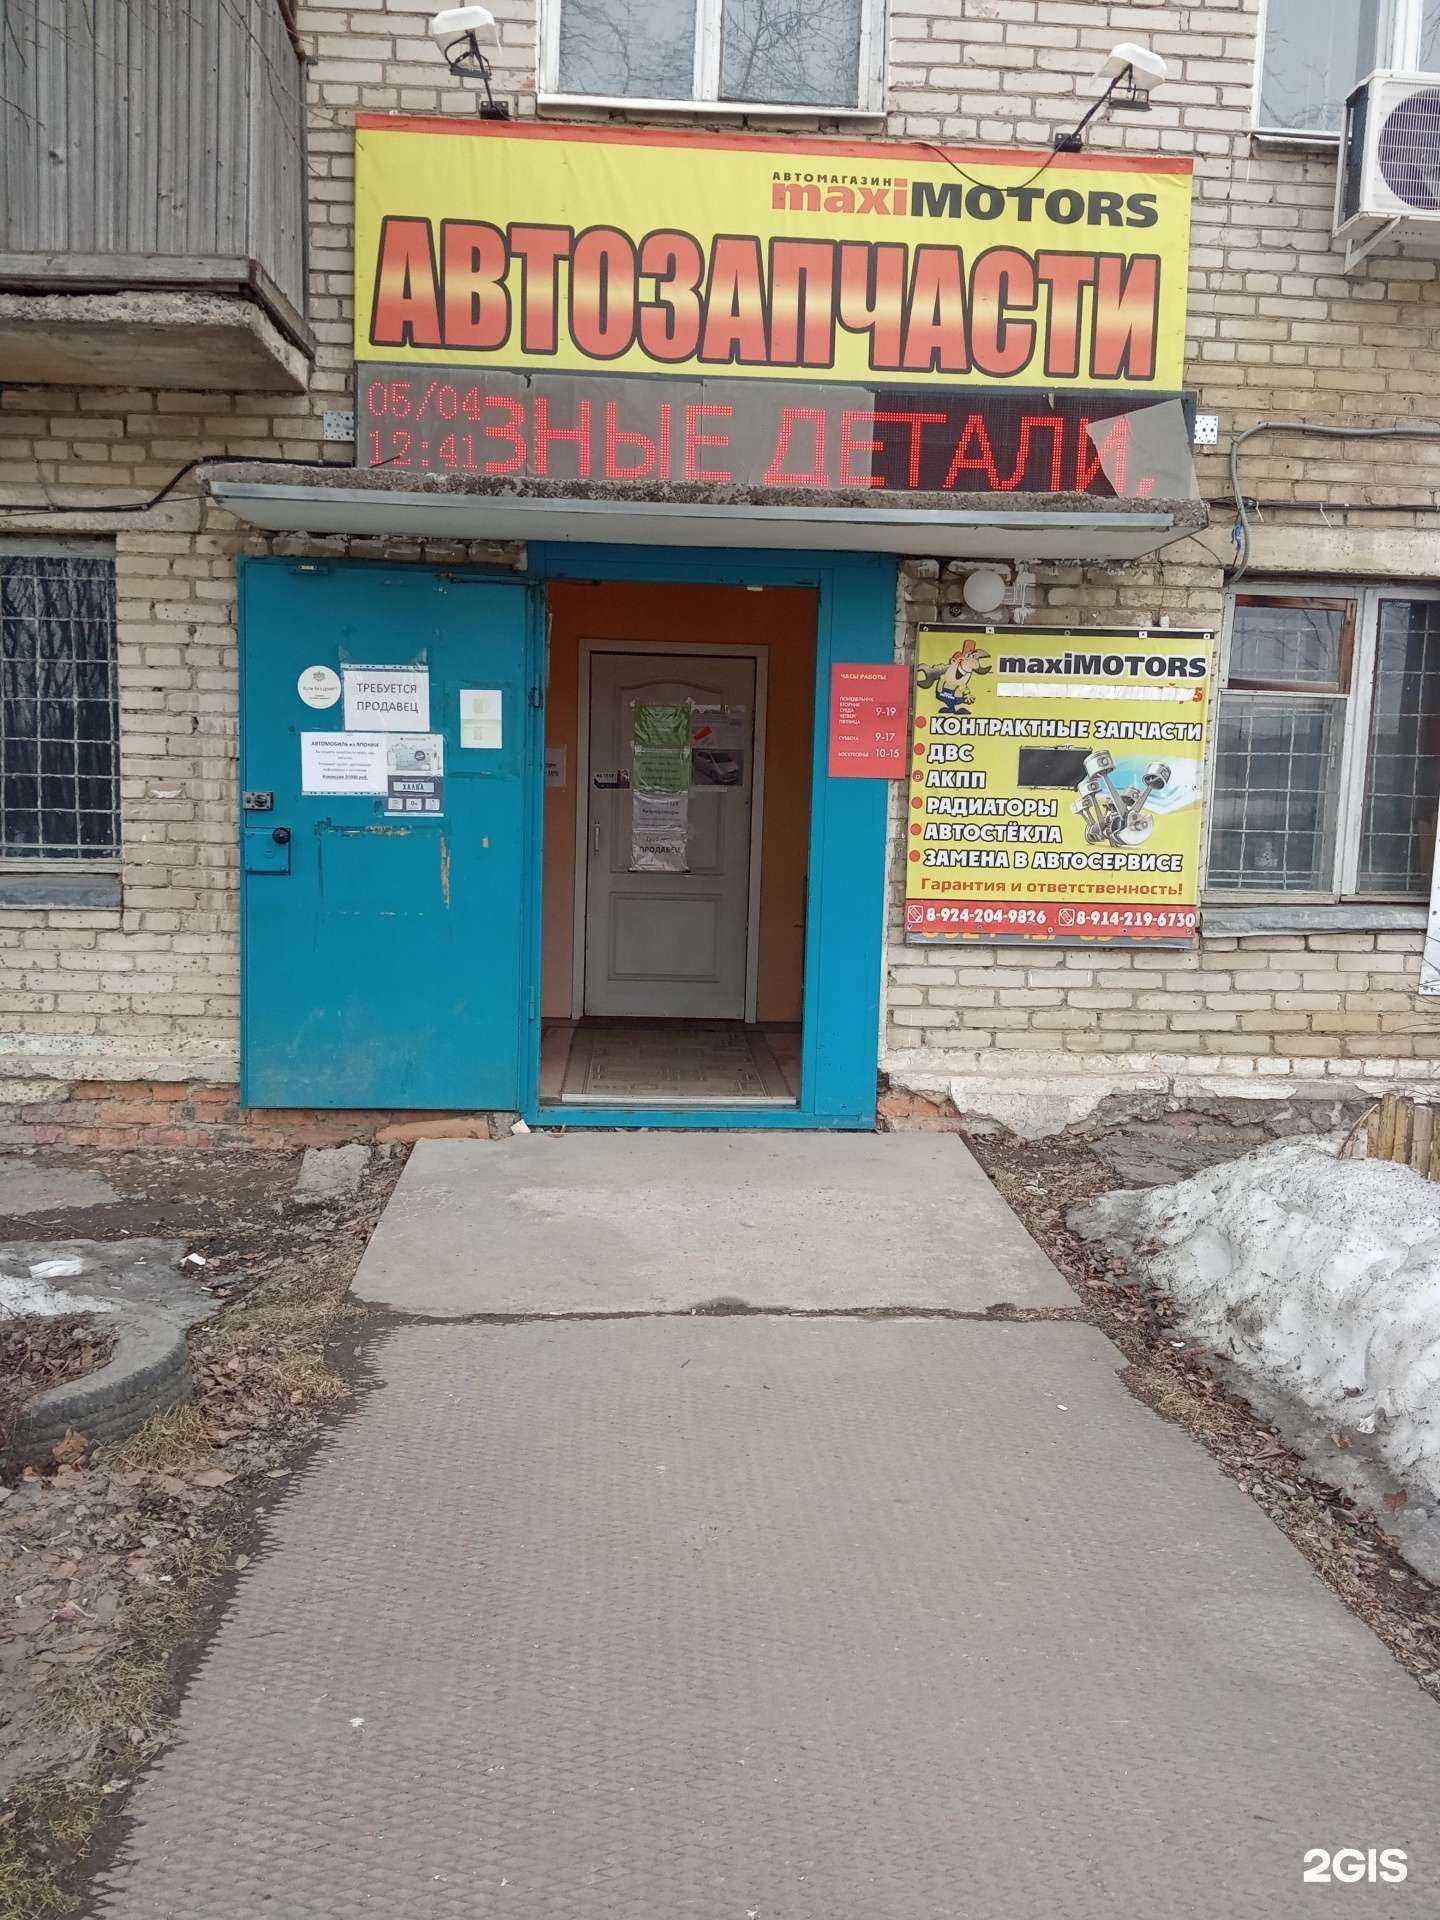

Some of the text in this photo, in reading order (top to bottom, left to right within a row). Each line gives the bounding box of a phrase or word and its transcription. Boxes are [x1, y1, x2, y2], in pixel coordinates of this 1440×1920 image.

[772, 171, 892, 186] АВТОМАГАЗИН
[771, 178, 1159, 228] maxiMOTORS
[369, 215, 1161, 381] АВТОЗАПЧАСТИ
[367, 381, 481, 422] 05/04
[484, 395, 734, 482] ЗНЫЕ
[368, 430, 478, 470] 12:41
[998, 652, 1208, 678] maxiMOTORS
[859, 673, 887, 681] РАБОТЫ
[356, 682, 417, 694] ТРЕБУЕТСЯ
[356, 701, 419, 713] ПРОДАВЕЦ
[875, 707, 896, 717] 9-19
[875, 732, 896, 742] 9-17
[929, 717, 1202, 742] КОНТРАКТНЫЕ ЗАПЧАСТИ
[875, 749, 900, 758] 10-15
[926, 743, 974, 764] ДВС
[925, 770, 987, 789] АКПП
[926, 796, 1058, 818] РАДИАТОРЫ
[924, 822, 1063, 844] АВТОСТЁКЛА
[923, 849, 1183, 873] ЗАМЕНА В АВТОСЕРВИСЕ
[921, 877, 1183, 896] Гарантия и ответственность!
[926, 908, 1046, 925] 8-924-204-9826
